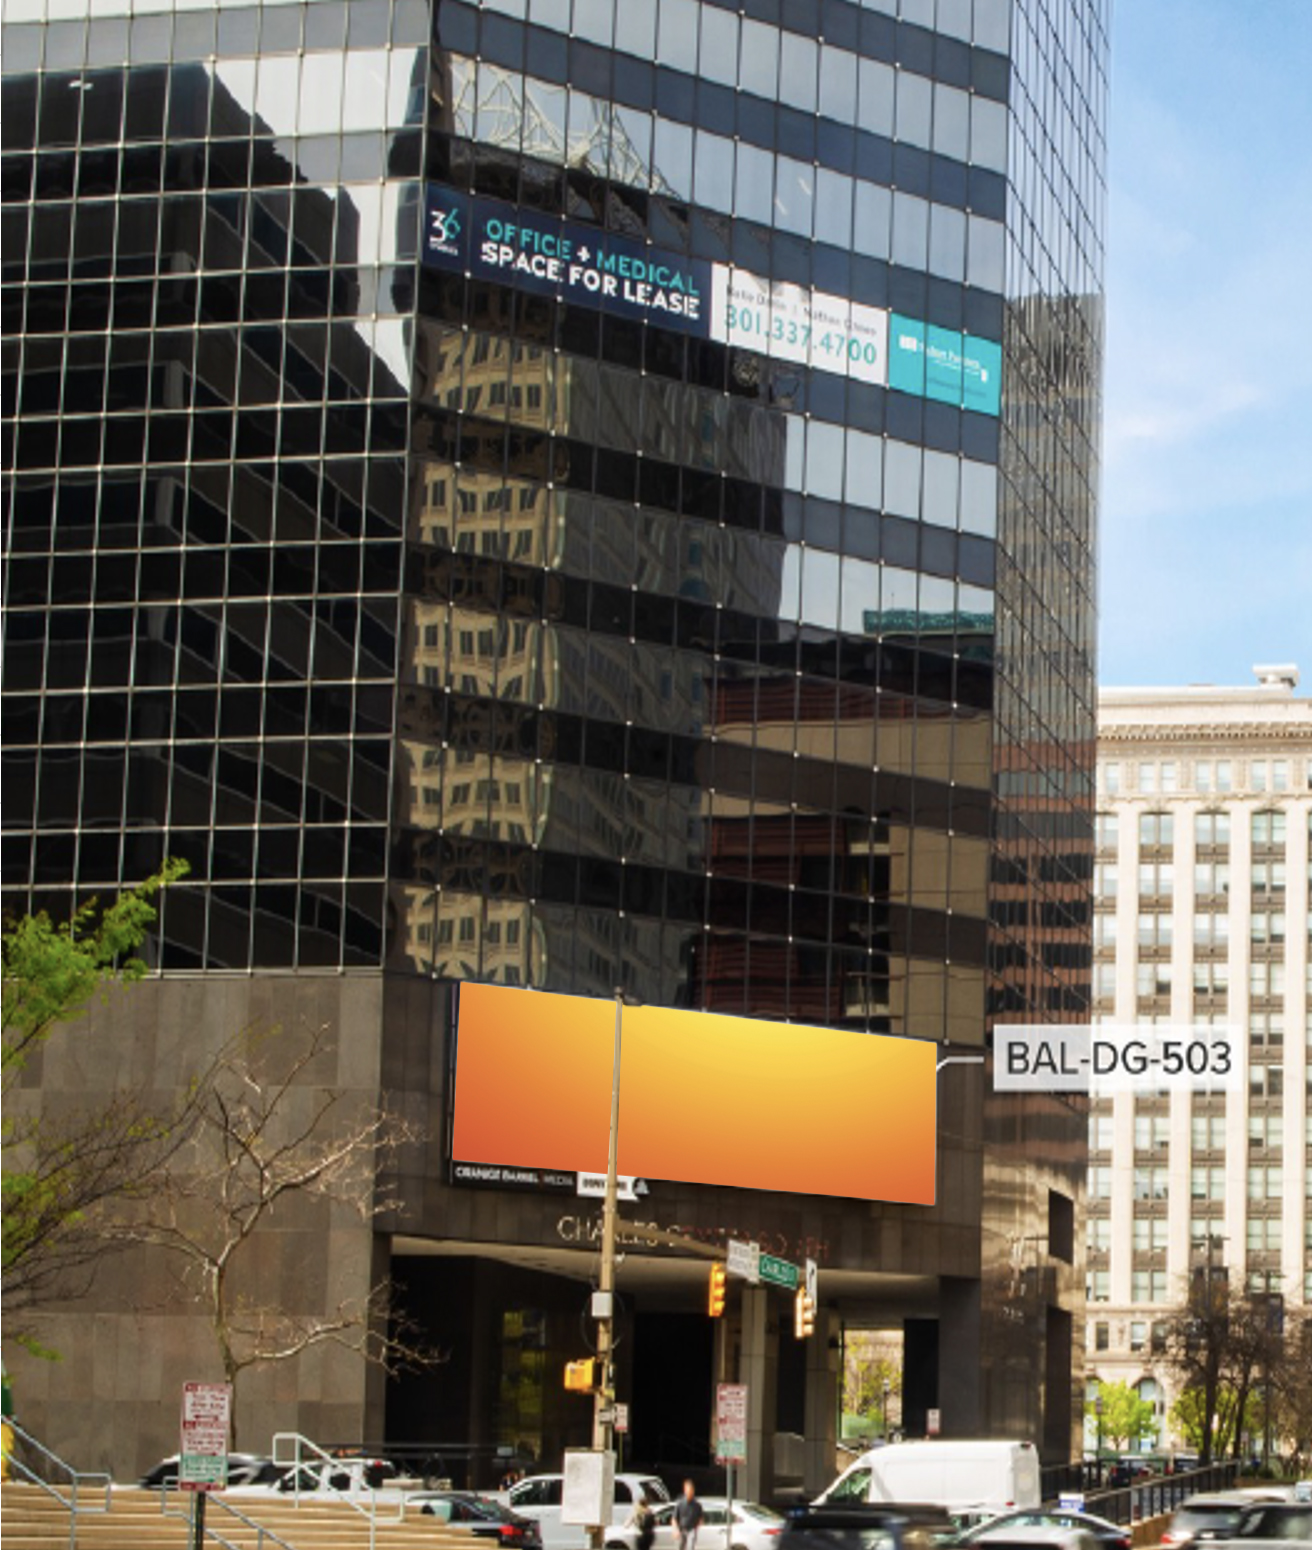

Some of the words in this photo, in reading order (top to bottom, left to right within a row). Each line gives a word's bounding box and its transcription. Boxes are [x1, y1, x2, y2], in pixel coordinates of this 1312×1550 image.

[480, 241, 564, 281] SPACE
[569, 264, 617, 297] FOR
[623, 279, 700, 319] LEASE
[486, 218, 572, 261] OFFICE
[596, 250, 700, 296] MEDICAL
[725, 304, 876, 365] 301.337.4700
[455, 1166, 500, 1182] ORANGE
